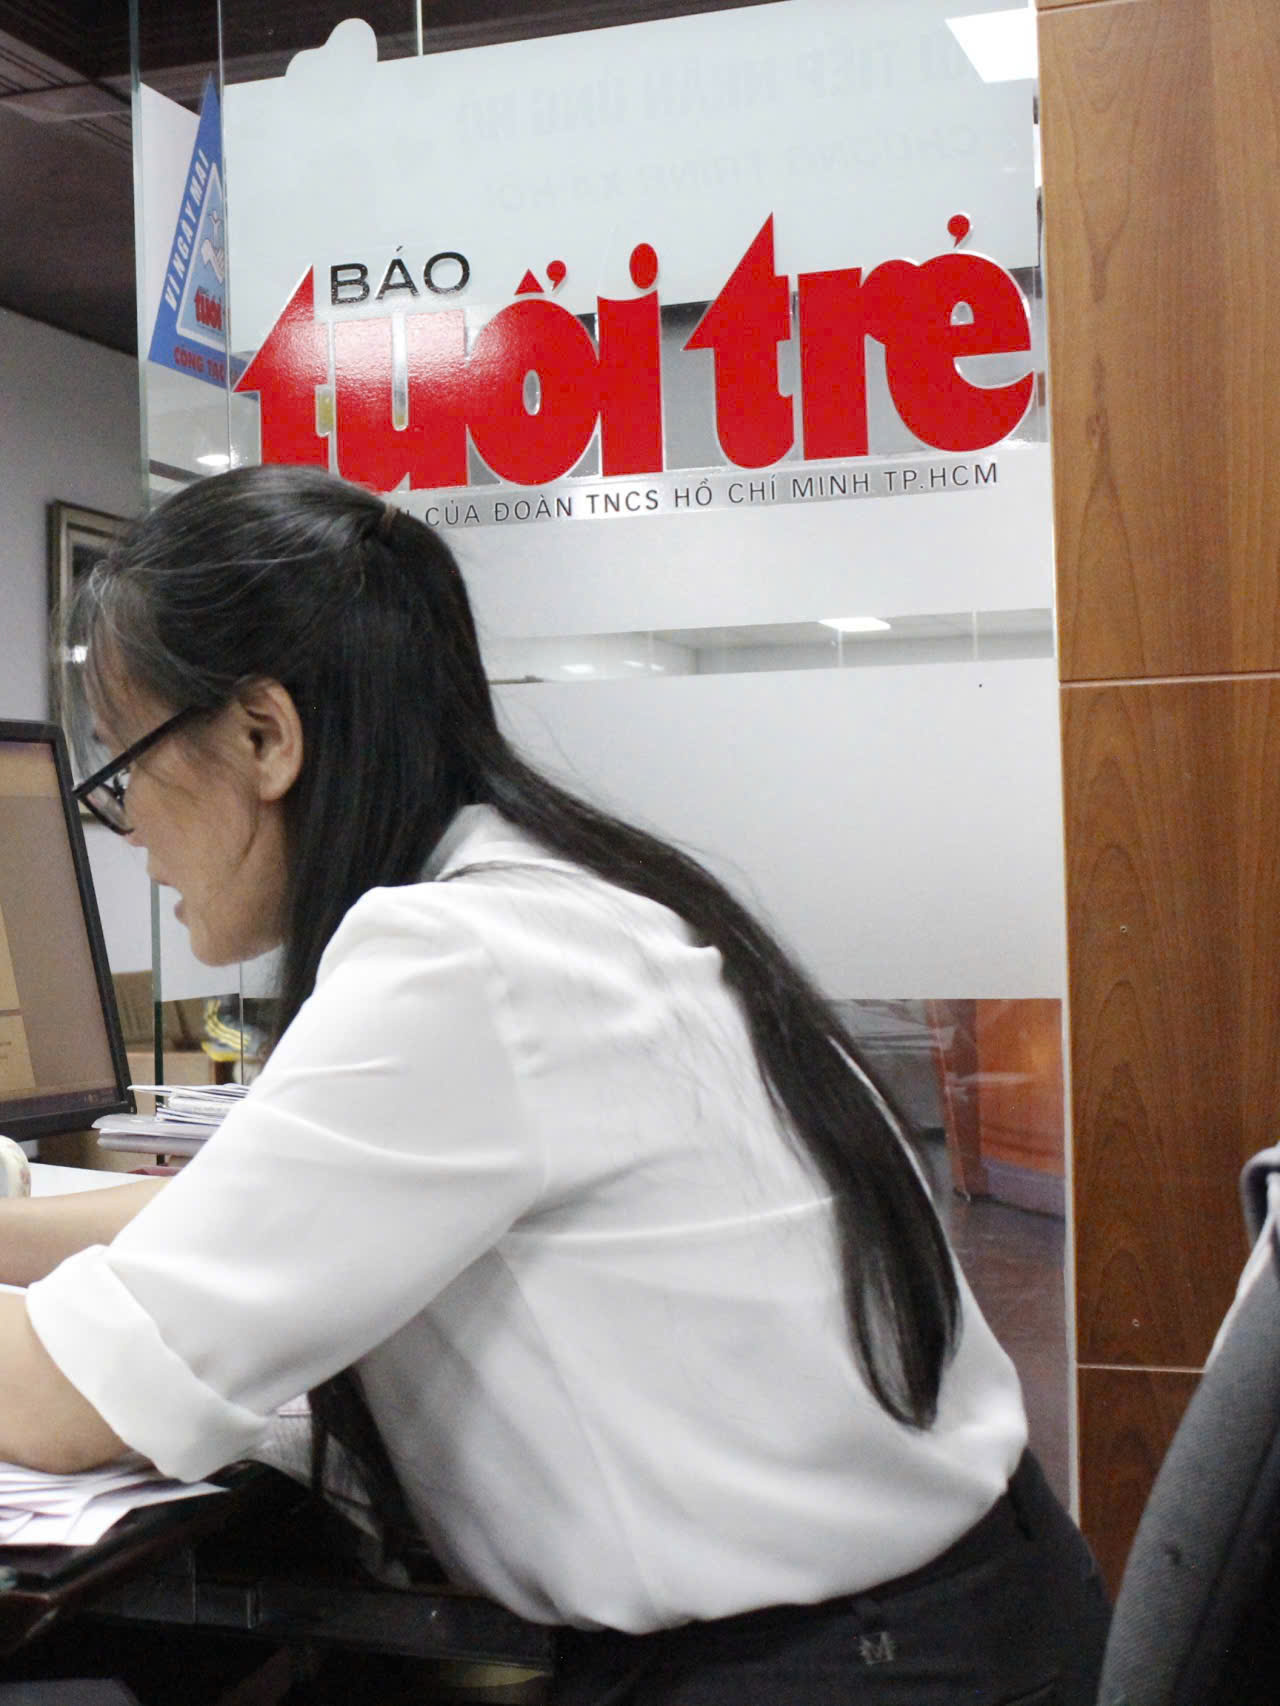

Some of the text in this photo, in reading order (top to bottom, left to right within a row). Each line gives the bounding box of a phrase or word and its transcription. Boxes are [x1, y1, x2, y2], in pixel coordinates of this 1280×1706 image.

[190, 149, 210, 206] MAI
[329, 245, 471, 306] BÁO
[682, 212, 1034, 471] trẻ
[425, 462, 998, 528] CỦA ĐOÀN TNCS HỒ CHÍ MINH TP.HCM
